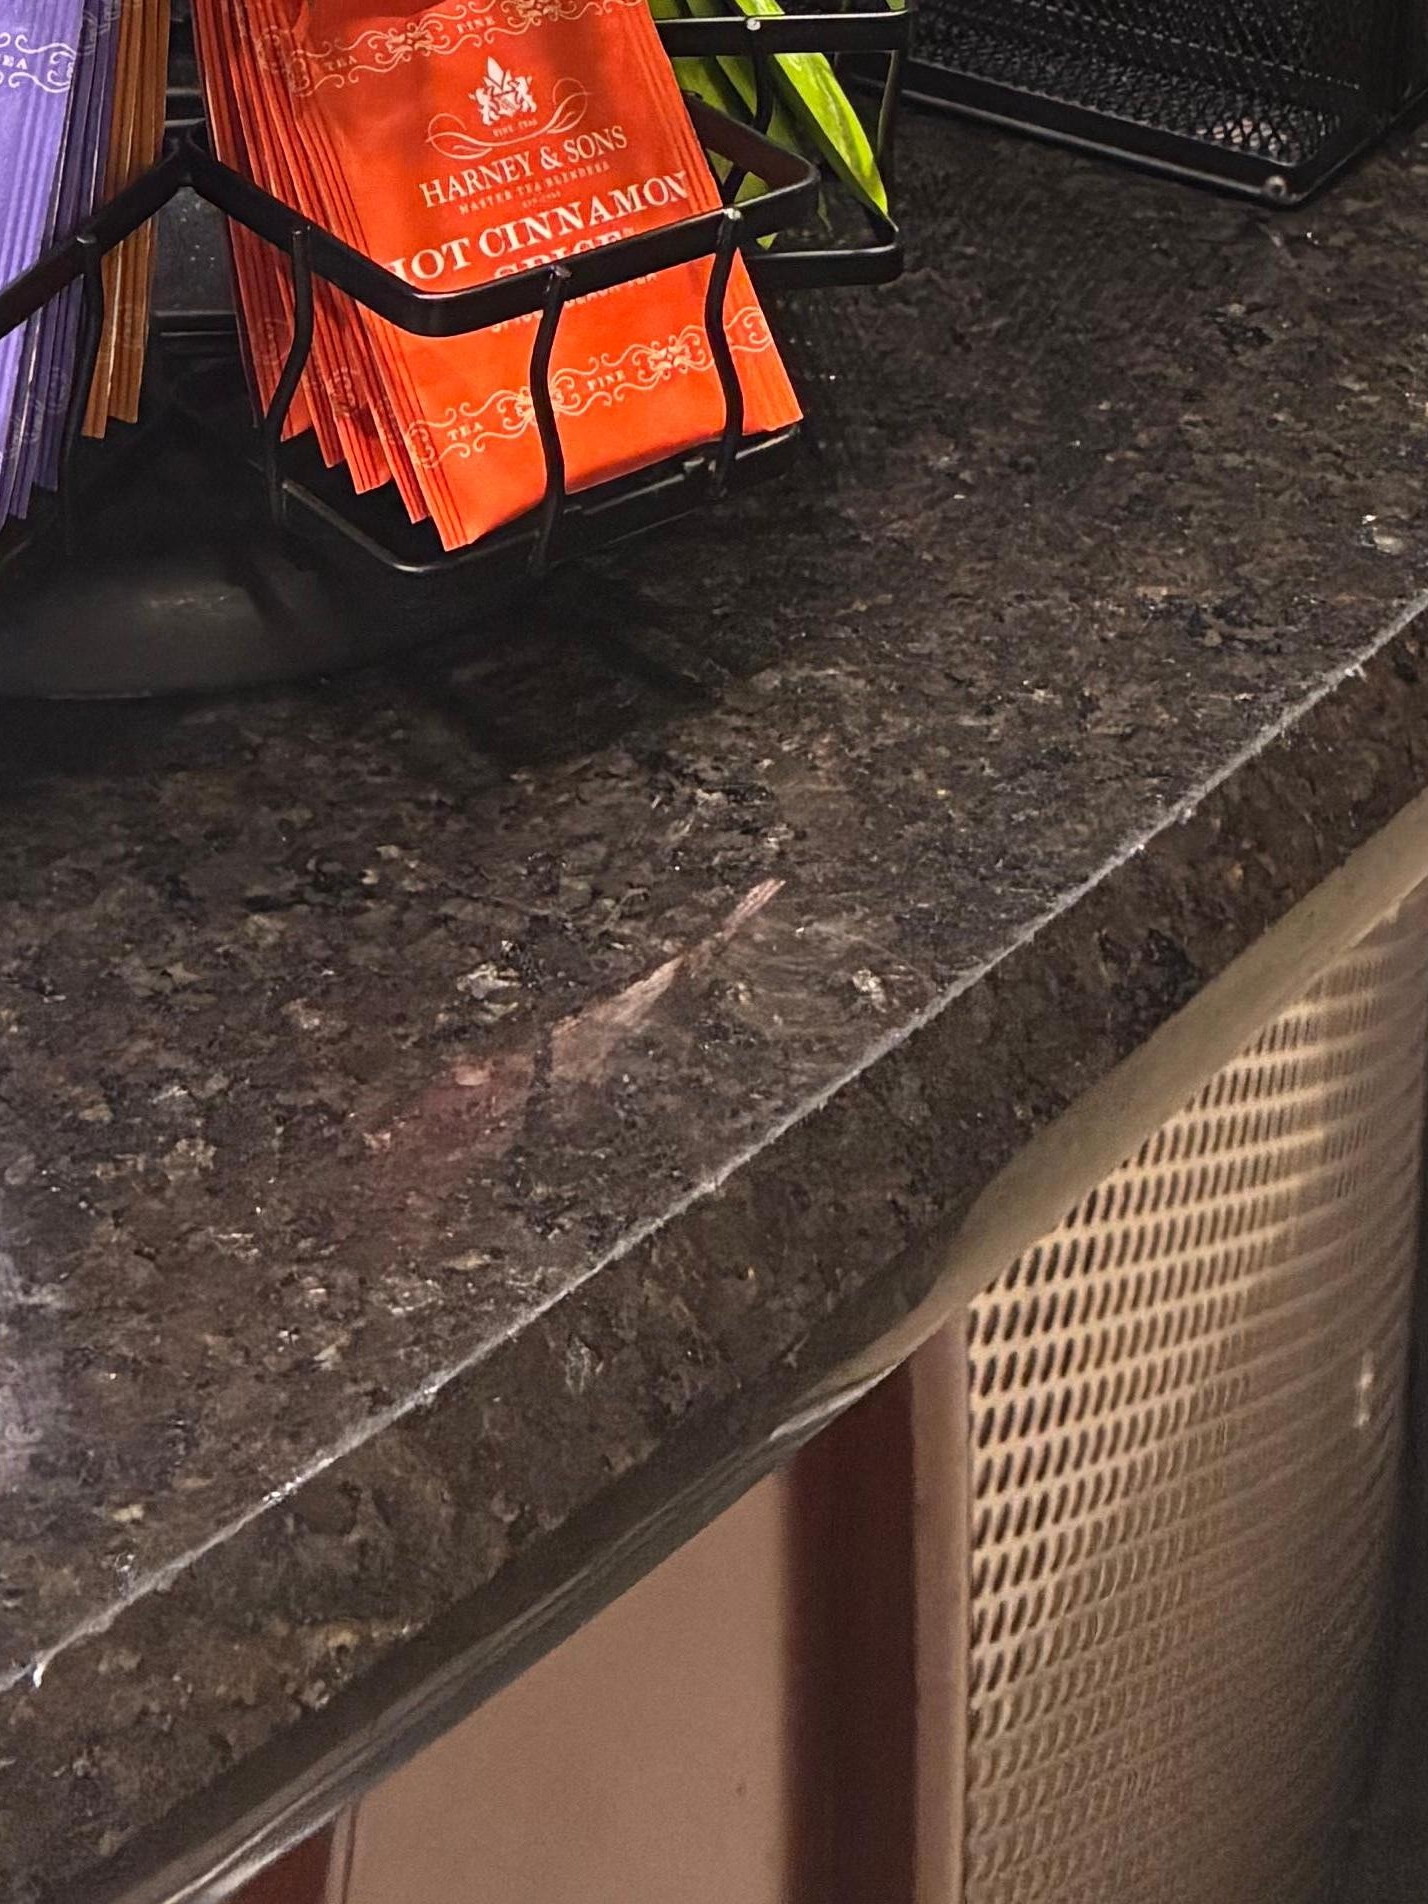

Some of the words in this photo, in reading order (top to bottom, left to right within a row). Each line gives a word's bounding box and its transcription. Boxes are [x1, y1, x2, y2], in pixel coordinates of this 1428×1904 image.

[327, 55, 358, 72] TEA
[456, 15, 496, 34] FINE
[419, 151, 534, 209] HARNEY
[539, 145, 564, 171] &
[563, 125, 629, 164] SONS
[478, 169, 691, 258] CINNAMON
[446, 421, 484, 442] TEA
[586, 369, 626, 392] FINE
